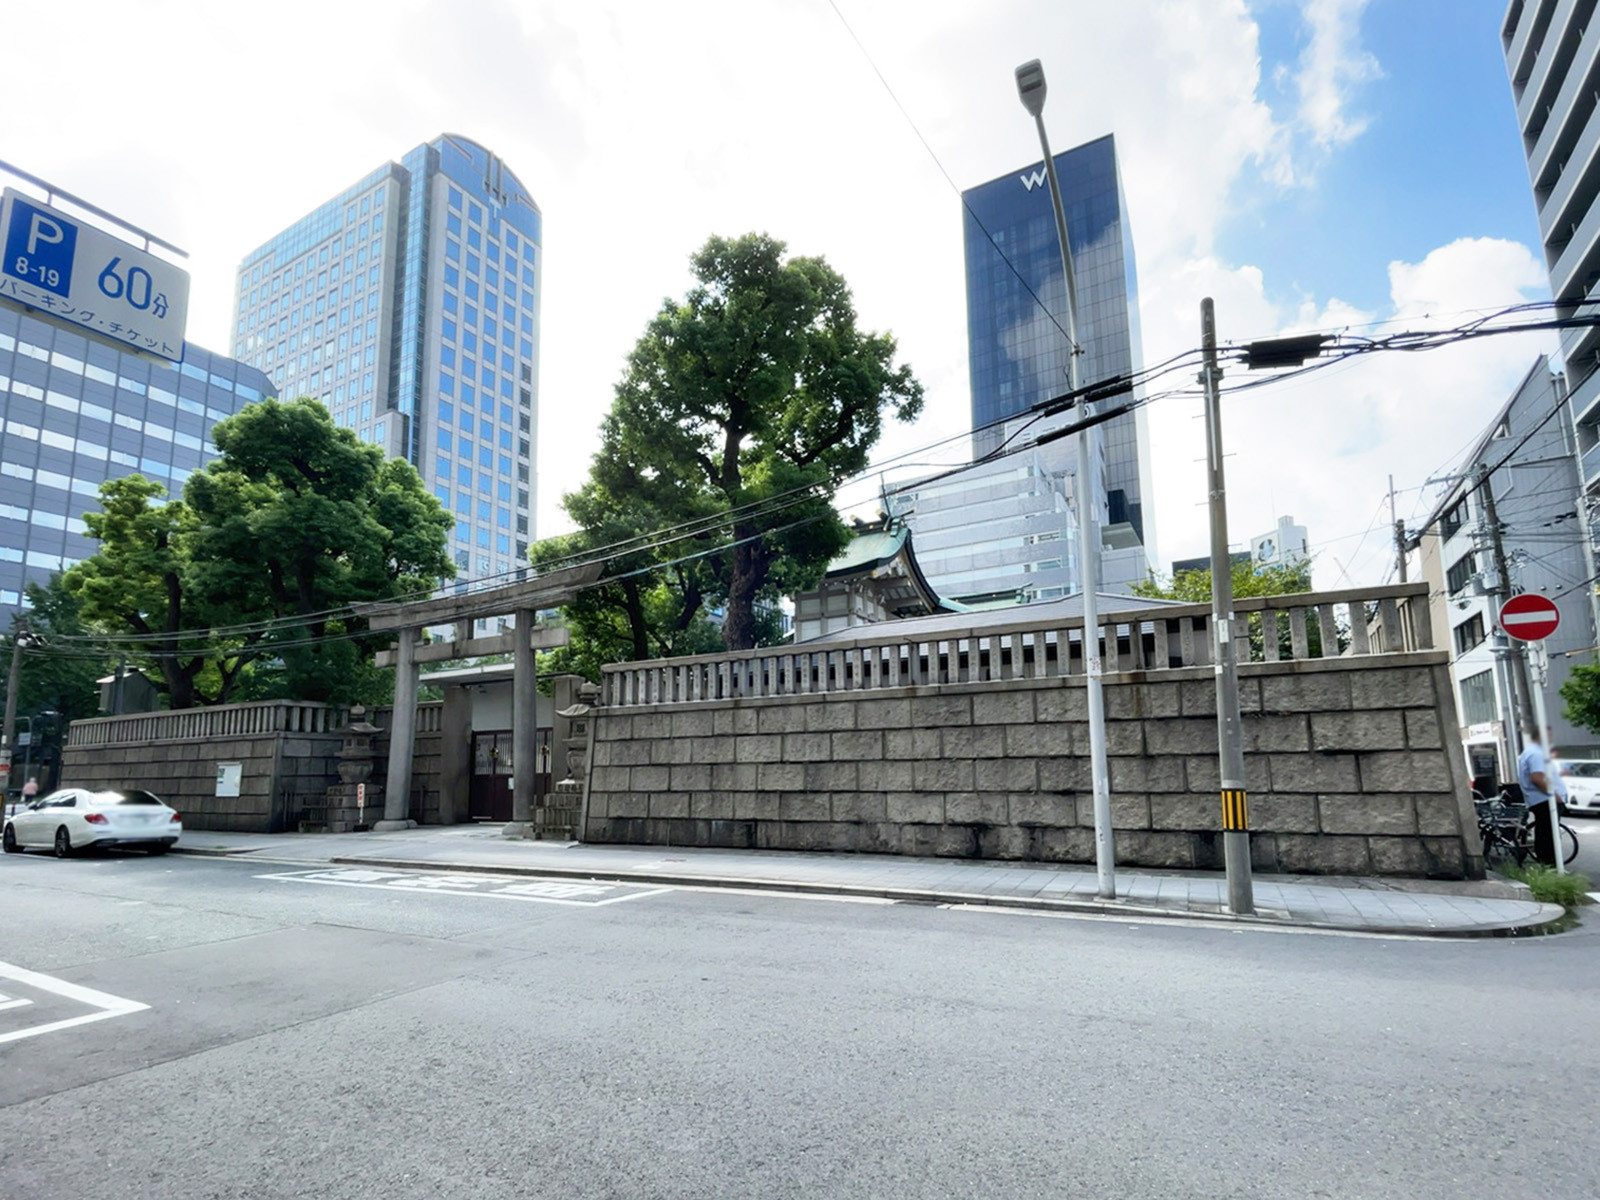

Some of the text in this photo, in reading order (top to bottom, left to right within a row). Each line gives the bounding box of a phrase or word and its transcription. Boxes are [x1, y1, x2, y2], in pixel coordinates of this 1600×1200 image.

[1020, 166, 1047, 191] W
[27, 212, 64, 255] P
[15, 256, 60, 287] 8-19
[98, 256, 169, 319] 60分
[0, 279, 174, 354] パーキング・チケット
